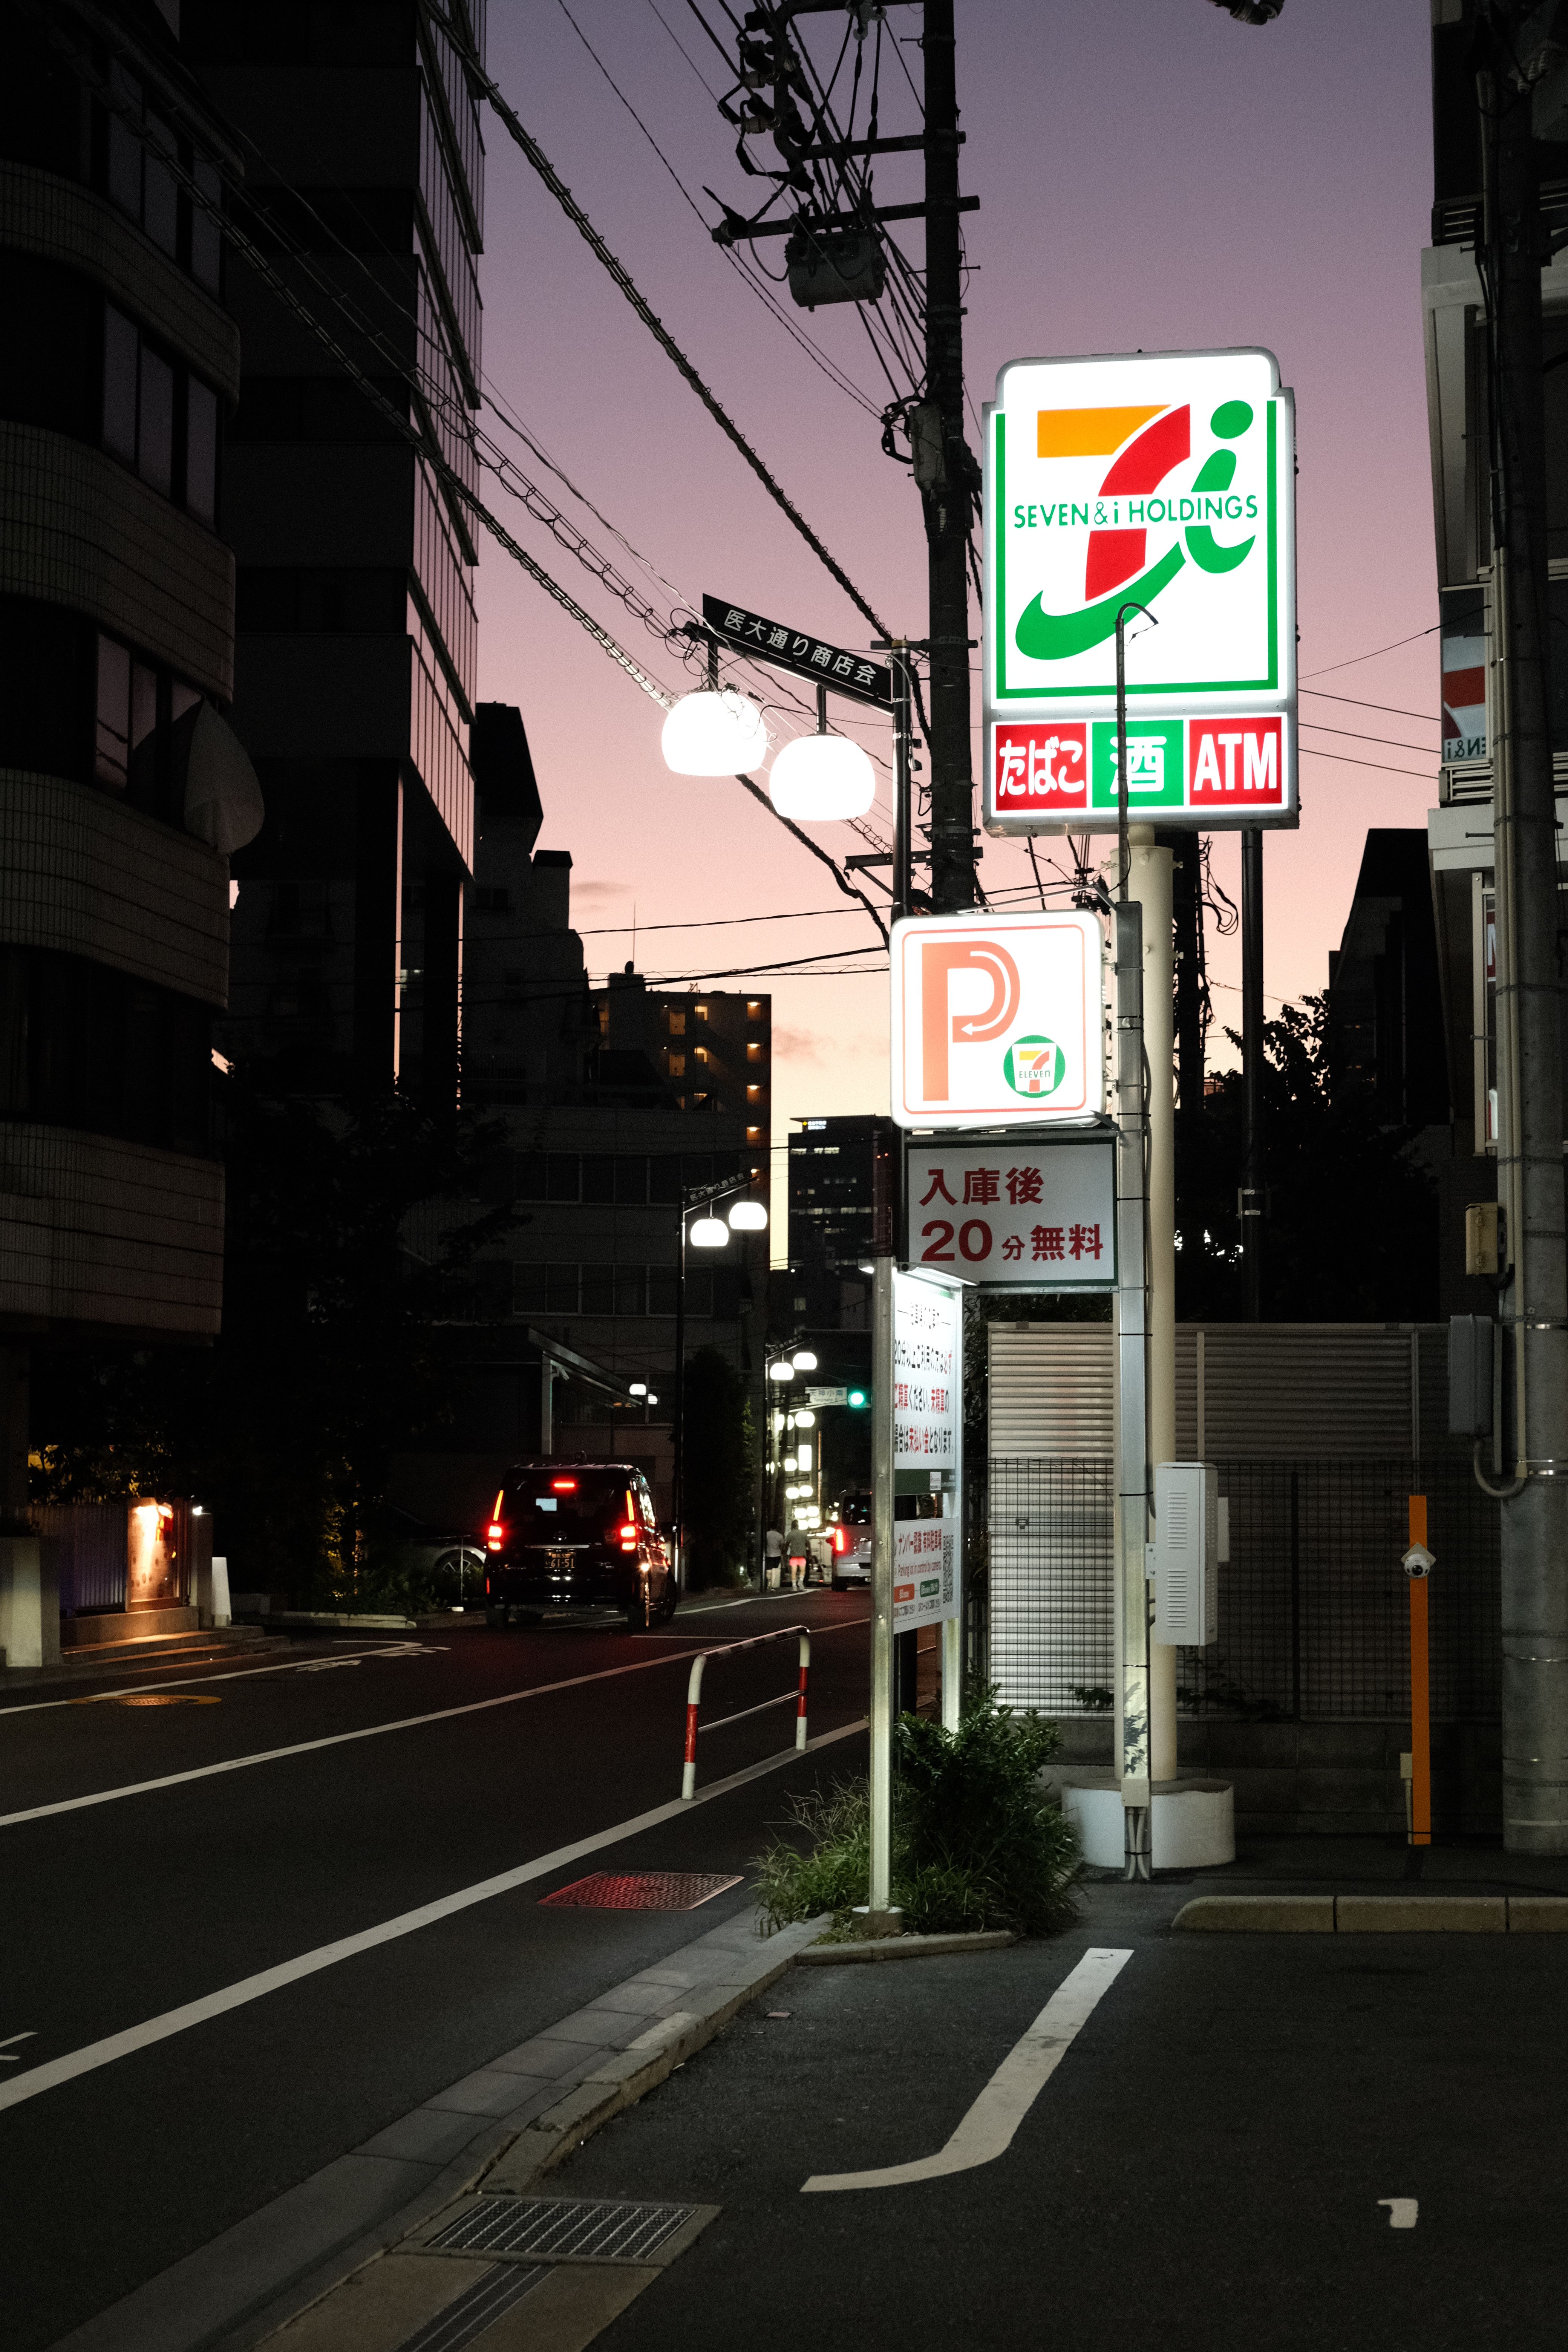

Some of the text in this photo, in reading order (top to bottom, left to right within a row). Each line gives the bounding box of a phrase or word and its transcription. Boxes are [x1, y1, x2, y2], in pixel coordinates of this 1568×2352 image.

[1129, 492, 1258, 528] HOLDINGS
[724, 609, 876, 686] 医大通り商店会
[999, 736, 1085, 796] たばこ
[1109, 736, 1167, 795] 酒
[1194, 732, 1277, 791] ATM
[919, 1167, 1044, 1207] 入庫後
